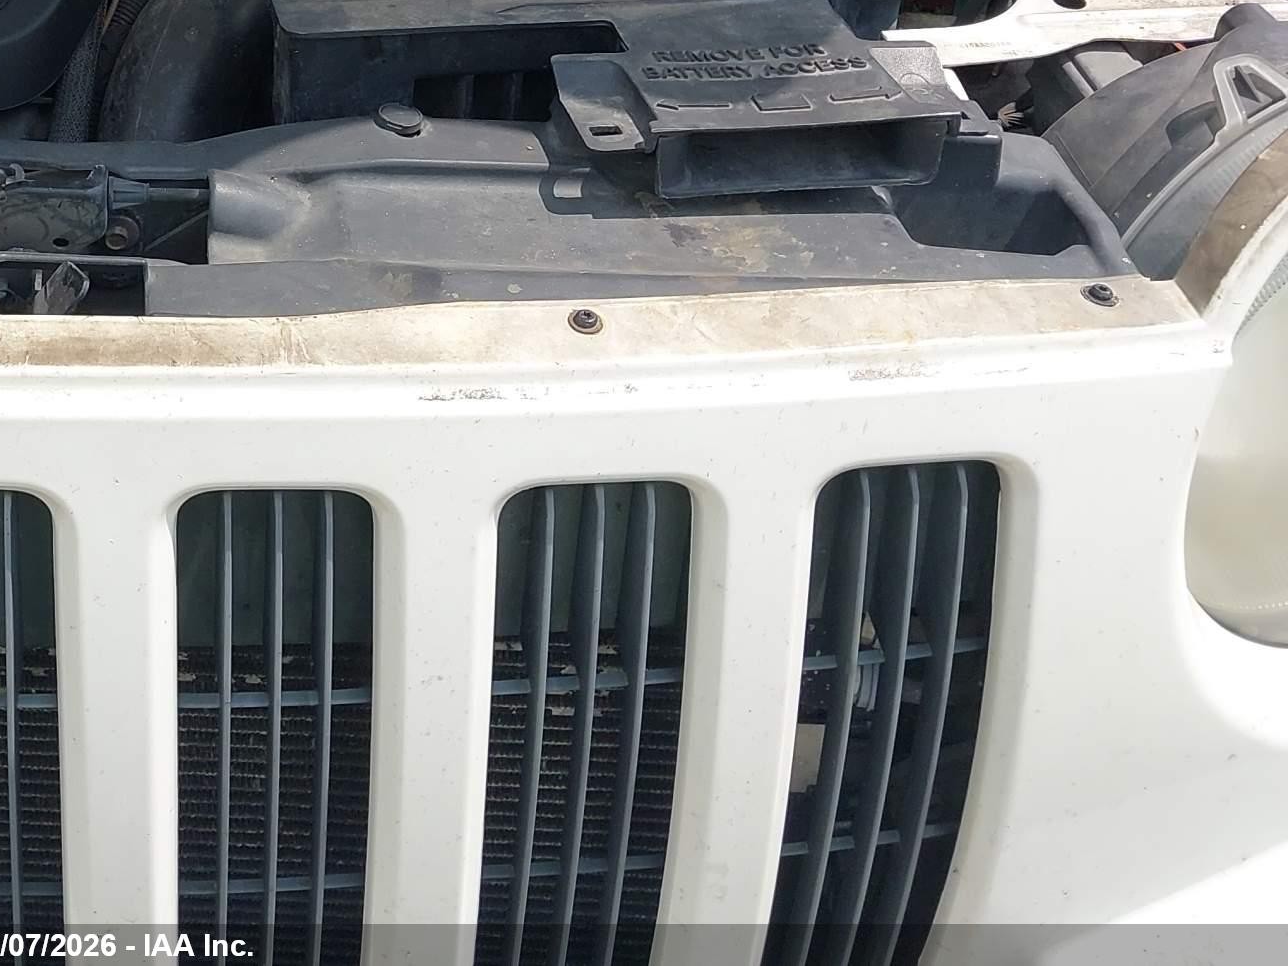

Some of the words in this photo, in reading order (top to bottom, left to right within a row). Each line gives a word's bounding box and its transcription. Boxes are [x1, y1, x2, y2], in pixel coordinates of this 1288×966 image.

[651, 47, 766, 64] REMOVE
[767, 42, 827, 59] FOR
[640, 64, 755, 81] BATTERY
[762, 55, 870, 78] ACCESS
